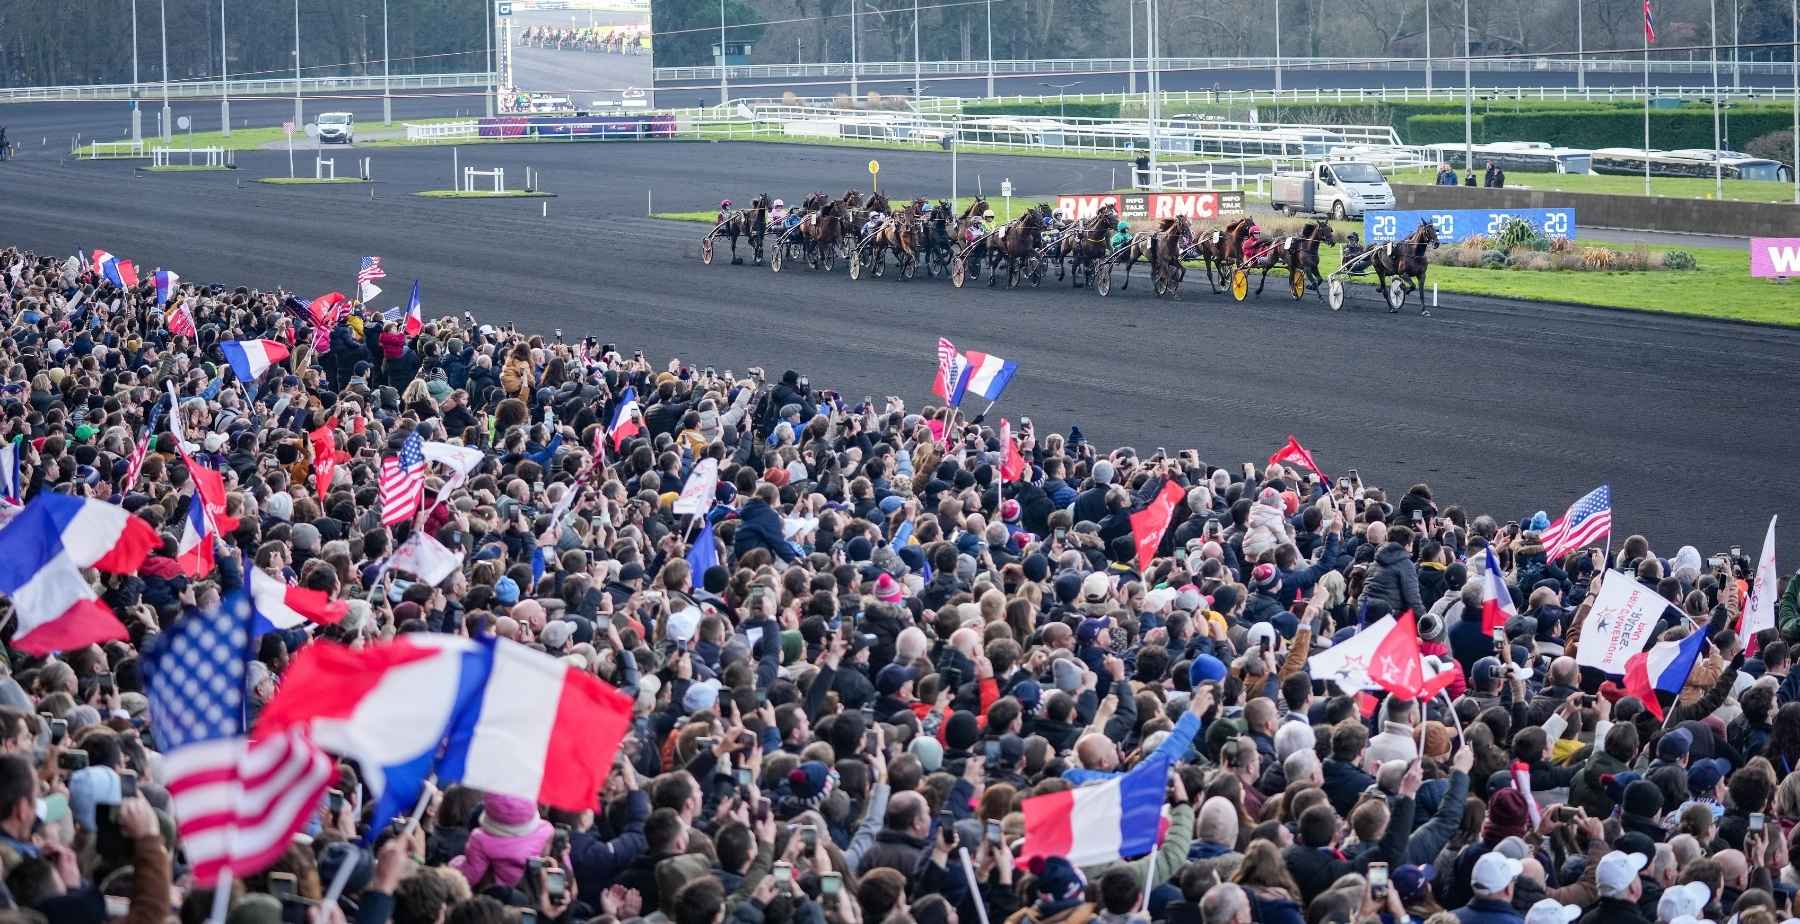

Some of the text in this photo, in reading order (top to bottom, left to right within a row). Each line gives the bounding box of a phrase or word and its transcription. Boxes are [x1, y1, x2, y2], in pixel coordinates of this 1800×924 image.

[1155, 194, 1214, 219] RMC
[1372, 215, 1396, 235] 20
[1544, 212, 1568, 233] 20
